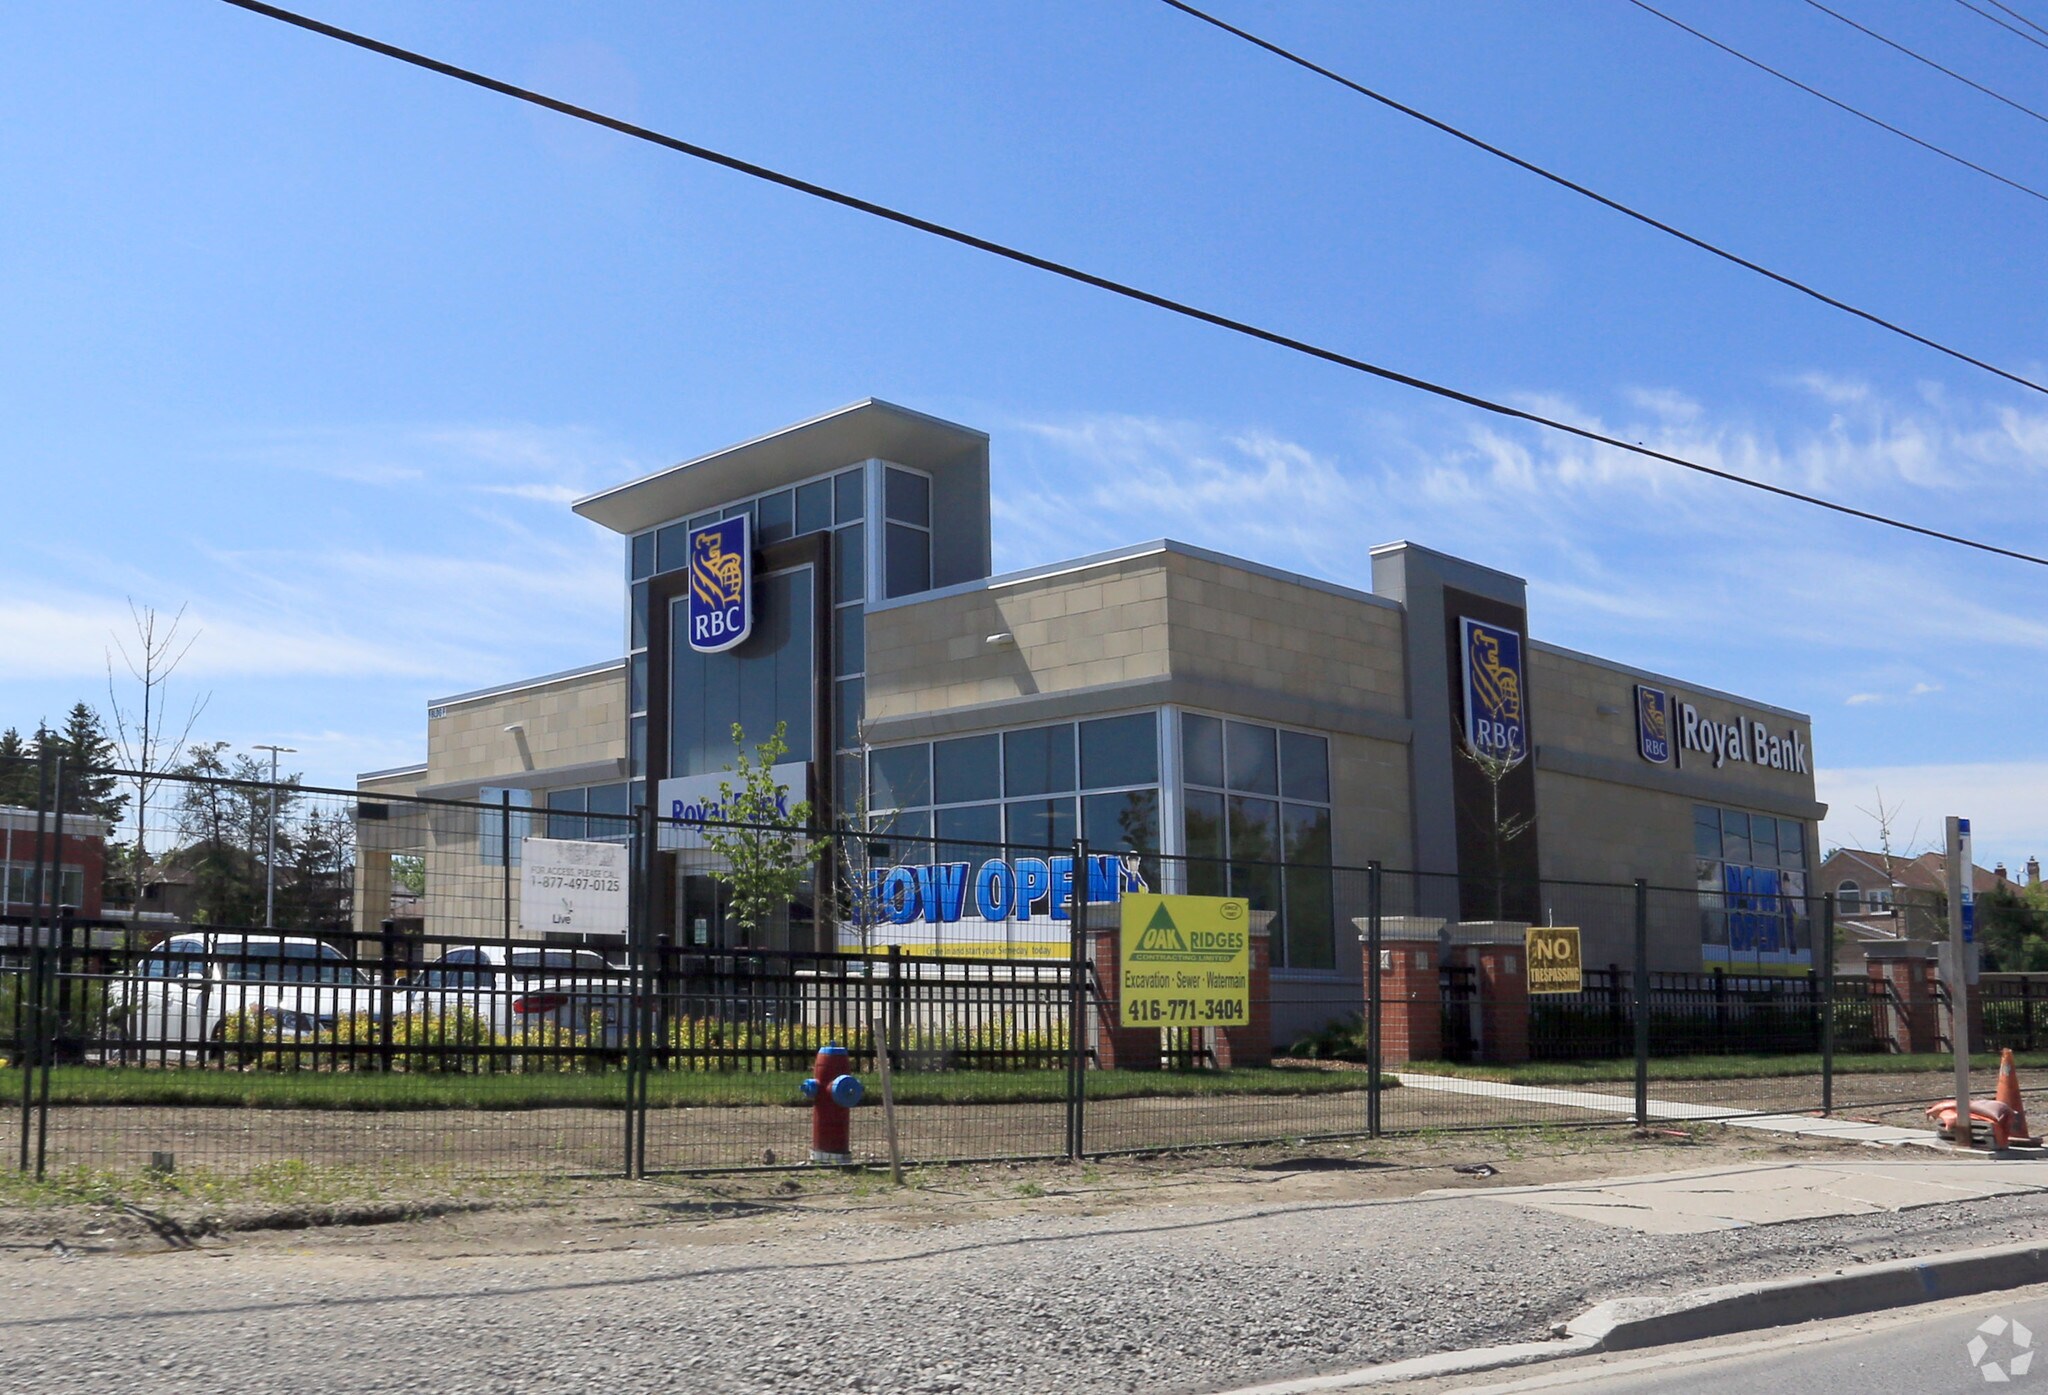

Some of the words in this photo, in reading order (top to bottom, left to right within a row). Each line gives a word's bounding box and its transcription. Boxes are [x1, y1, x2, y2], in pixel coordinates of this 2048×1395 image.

[695, 606, 740, 640] RBC
[1477, 718, 1521, 752] RBC
[1682, 703, 1750, 769] Royal
[1753, 721, 1808, 775] Bank
[1645, 738, 1667, 757] RBC
[578, 869, 600, 878] PLEASE
[531, 876, 620, 892] 1-877-497-0125
[974, 854, 1121, 922] OPEN
[1142, 928, 1182, 950] OAK
[1190, 931, 1244, 948] RIDGES
[1537, 937, 1571, 960] NO
[1032, 946, 1052, 956] today
[1198, 954, 1230, 962] LIMITED
[1125, 970, 1170, 989] Excavation
[1176, 970, 1201, 989] Sewer
[1206, 971, 1246, 989] Watermain
[1530, 967, 1580, 983] TRESPASSING
[1128, 999, 1243, 1021] 416-771-3404
